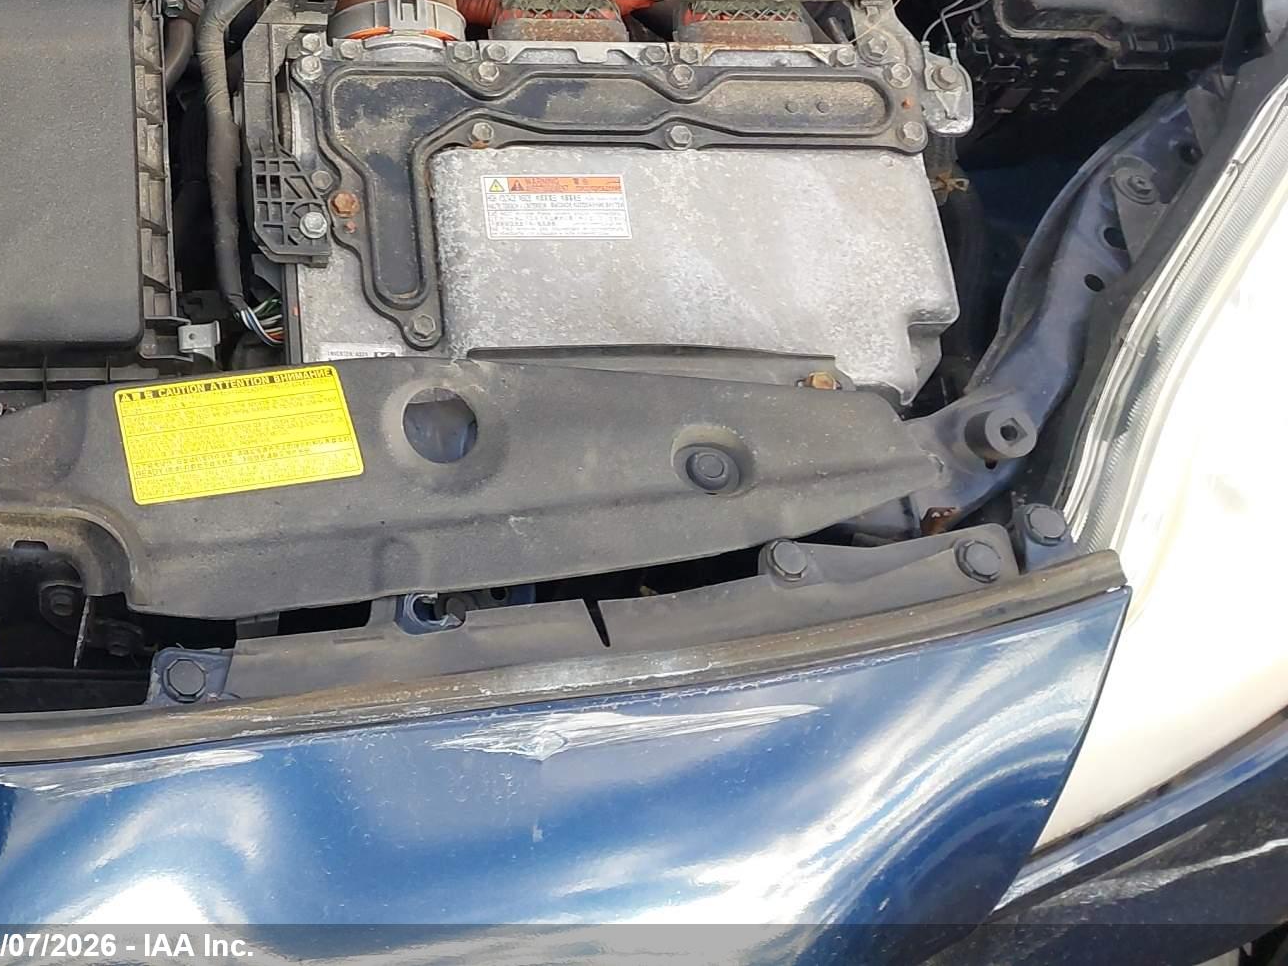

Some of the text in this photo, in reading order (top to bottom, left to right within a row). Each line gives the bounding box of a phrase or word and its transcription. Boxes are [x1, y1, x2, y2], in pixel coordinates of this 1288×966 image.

[158, 383, 206, 397] CAUTION
[210, 376, 270, 392] ATTENTION
[273, 368, 333, 384] ВНИМАНИЕ
